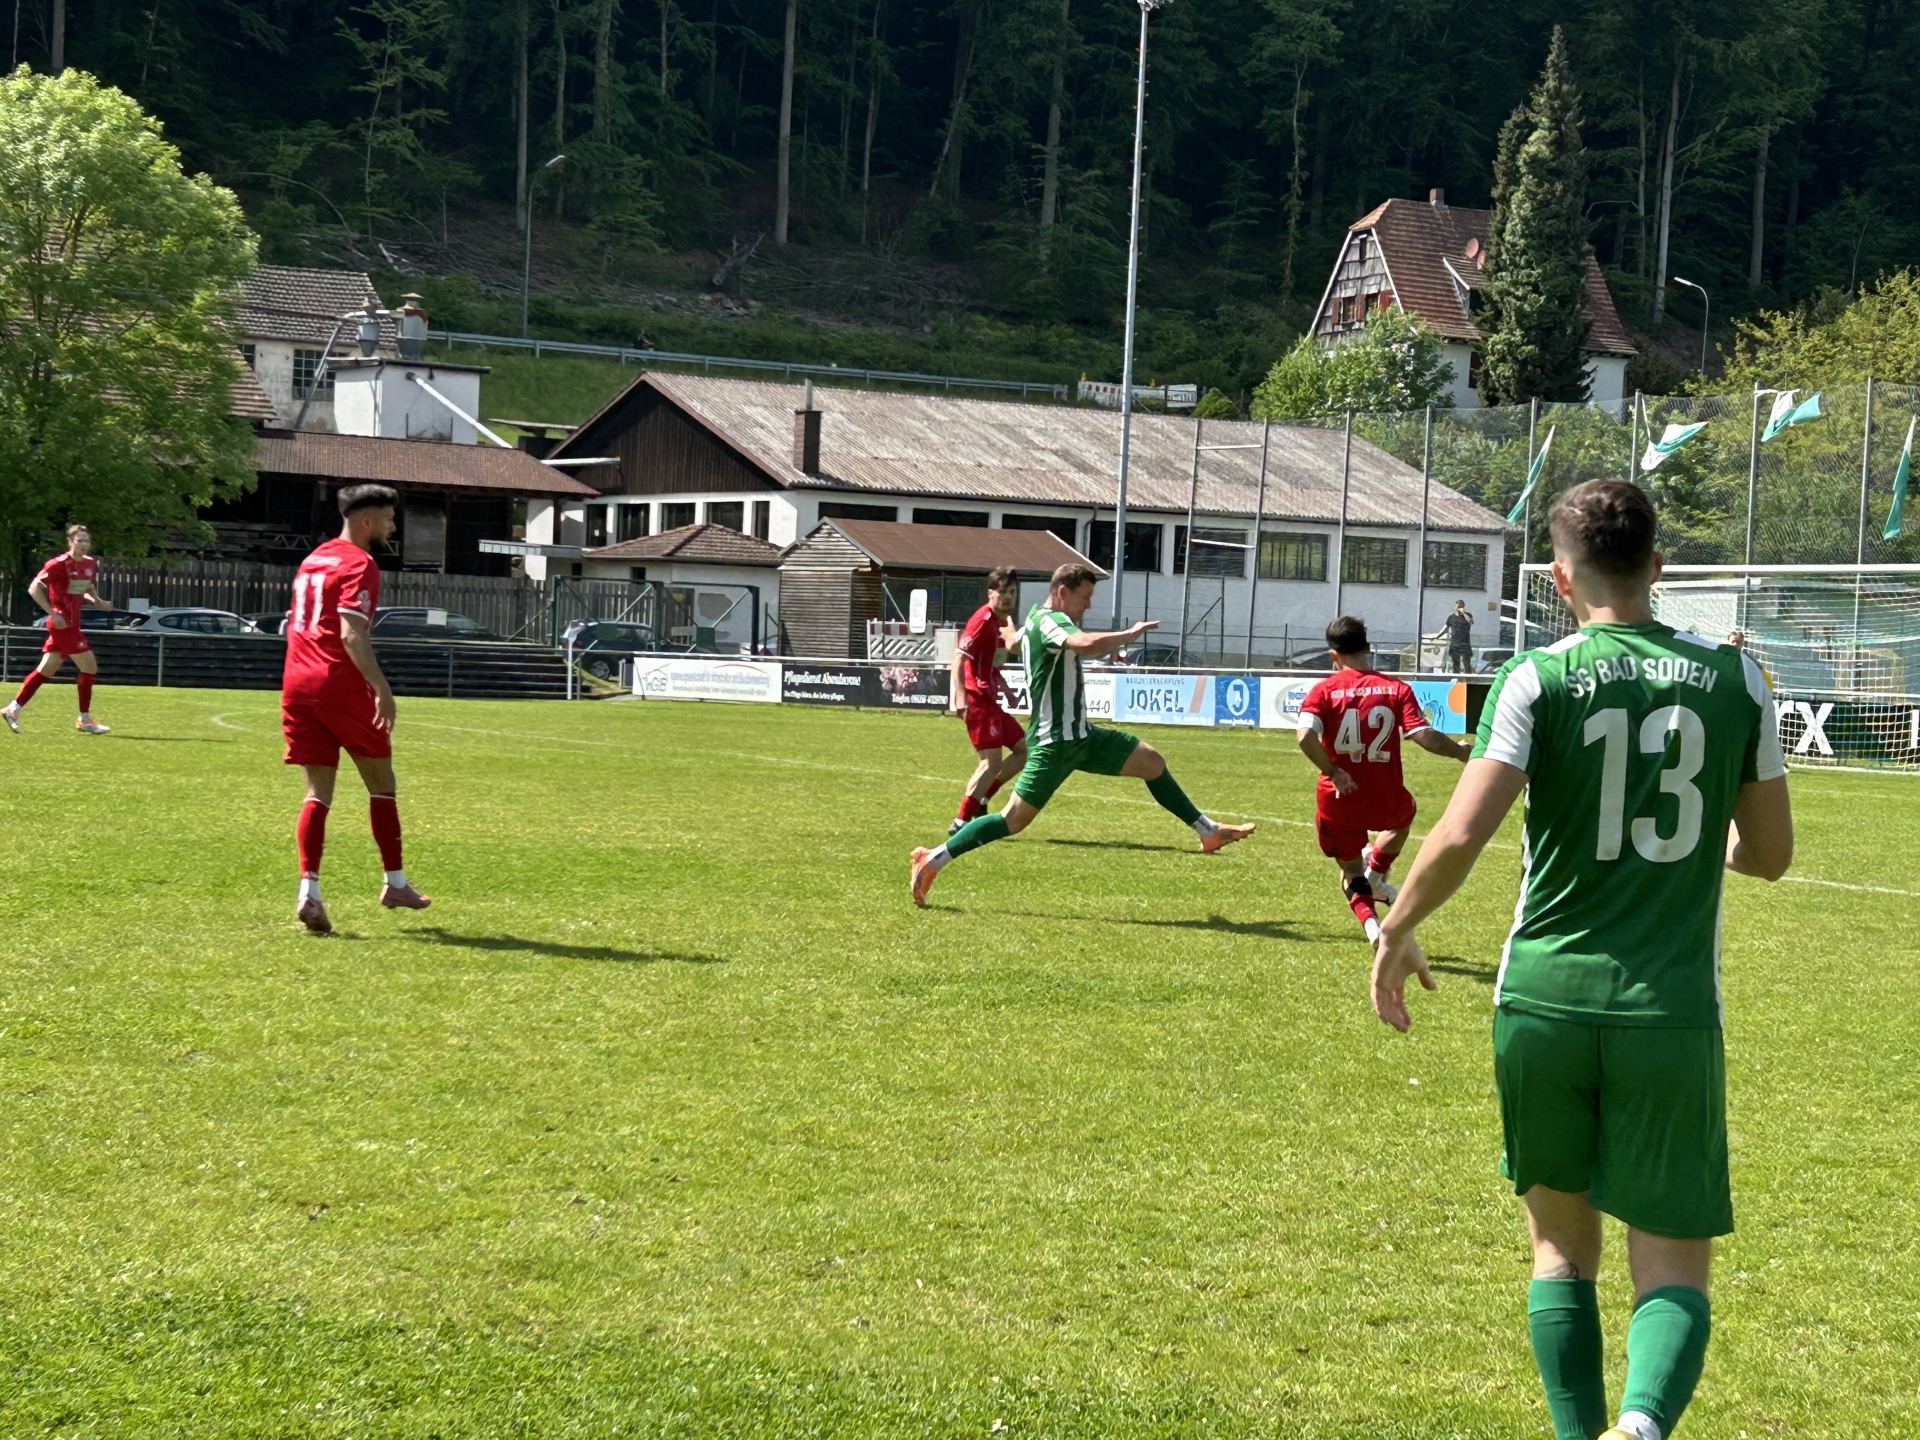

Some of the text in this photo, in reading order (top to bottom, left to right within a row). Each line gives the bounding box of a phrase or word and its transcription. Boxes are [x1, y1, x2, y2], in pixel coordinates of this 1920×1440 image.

[1565, 656, 1718, 699] SG BAD SODEN
[1334, 705, 1396, 763] 42
[1584, 704, 1706, 863] 13
